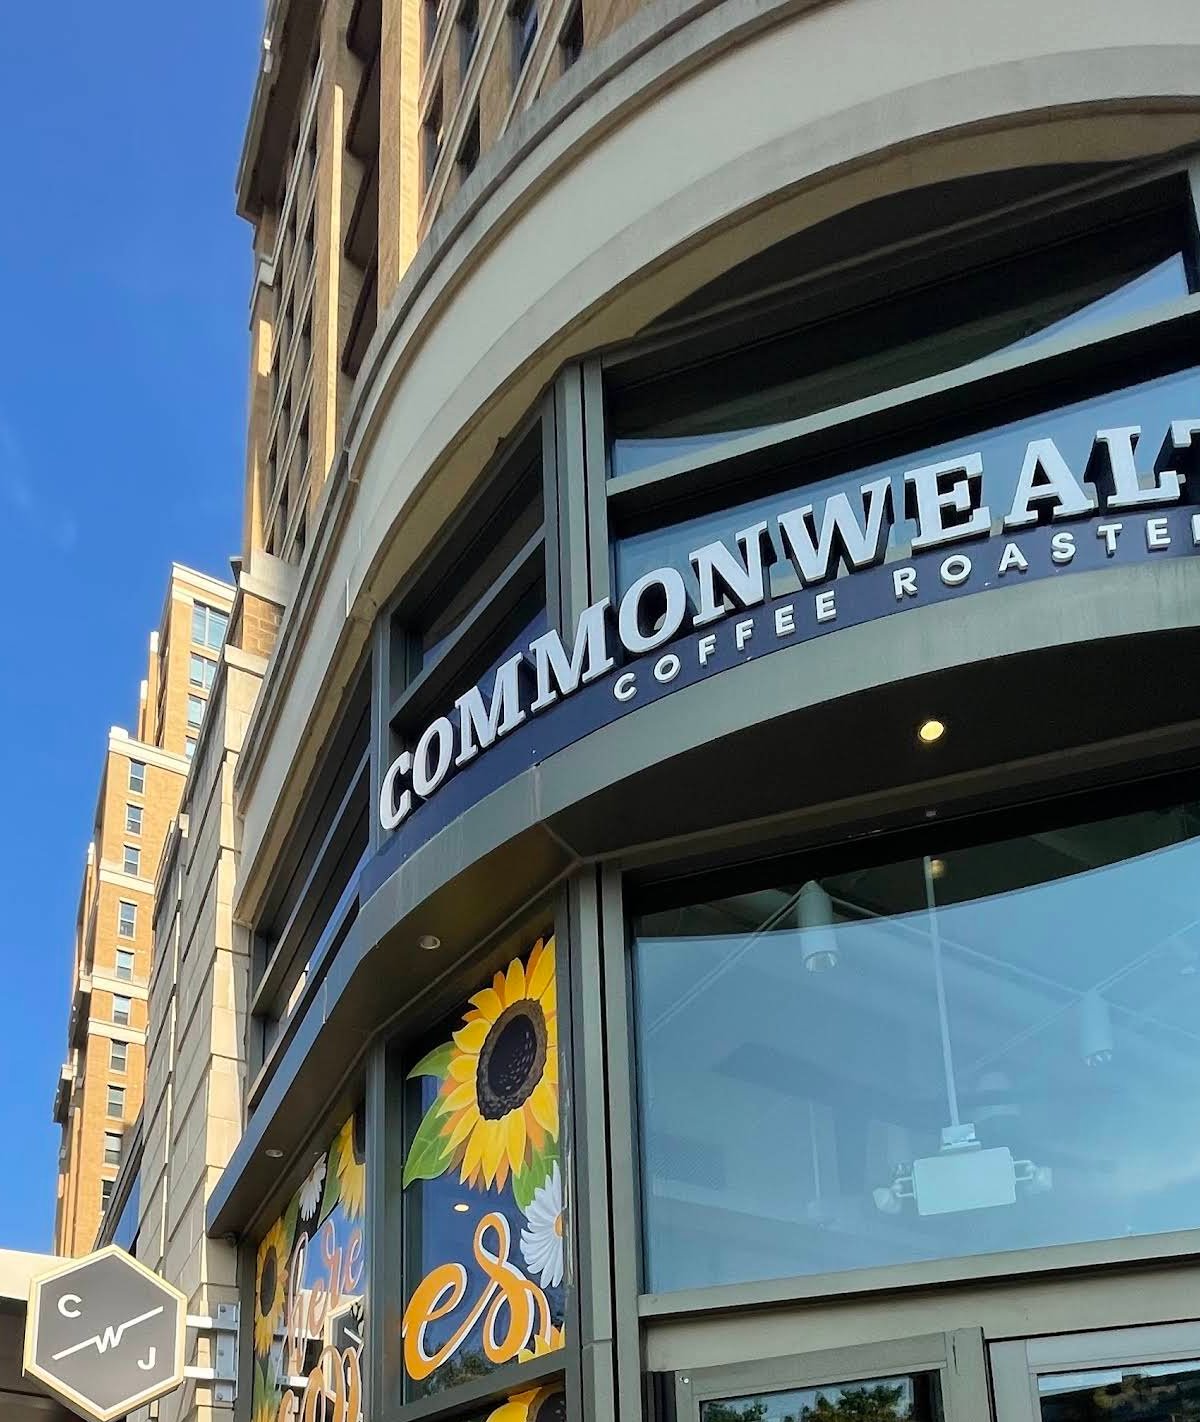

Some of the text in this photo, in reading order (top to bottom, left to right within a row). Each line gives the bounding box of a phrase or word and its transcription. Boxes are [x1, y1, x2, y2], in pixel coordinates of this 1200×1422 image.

[613, 590, 837, 702] COFFEE
[57, 1294, 82, 1318] C
[276, 1218, 365, 1385] here
[137, 1347, 157, 1370] J
